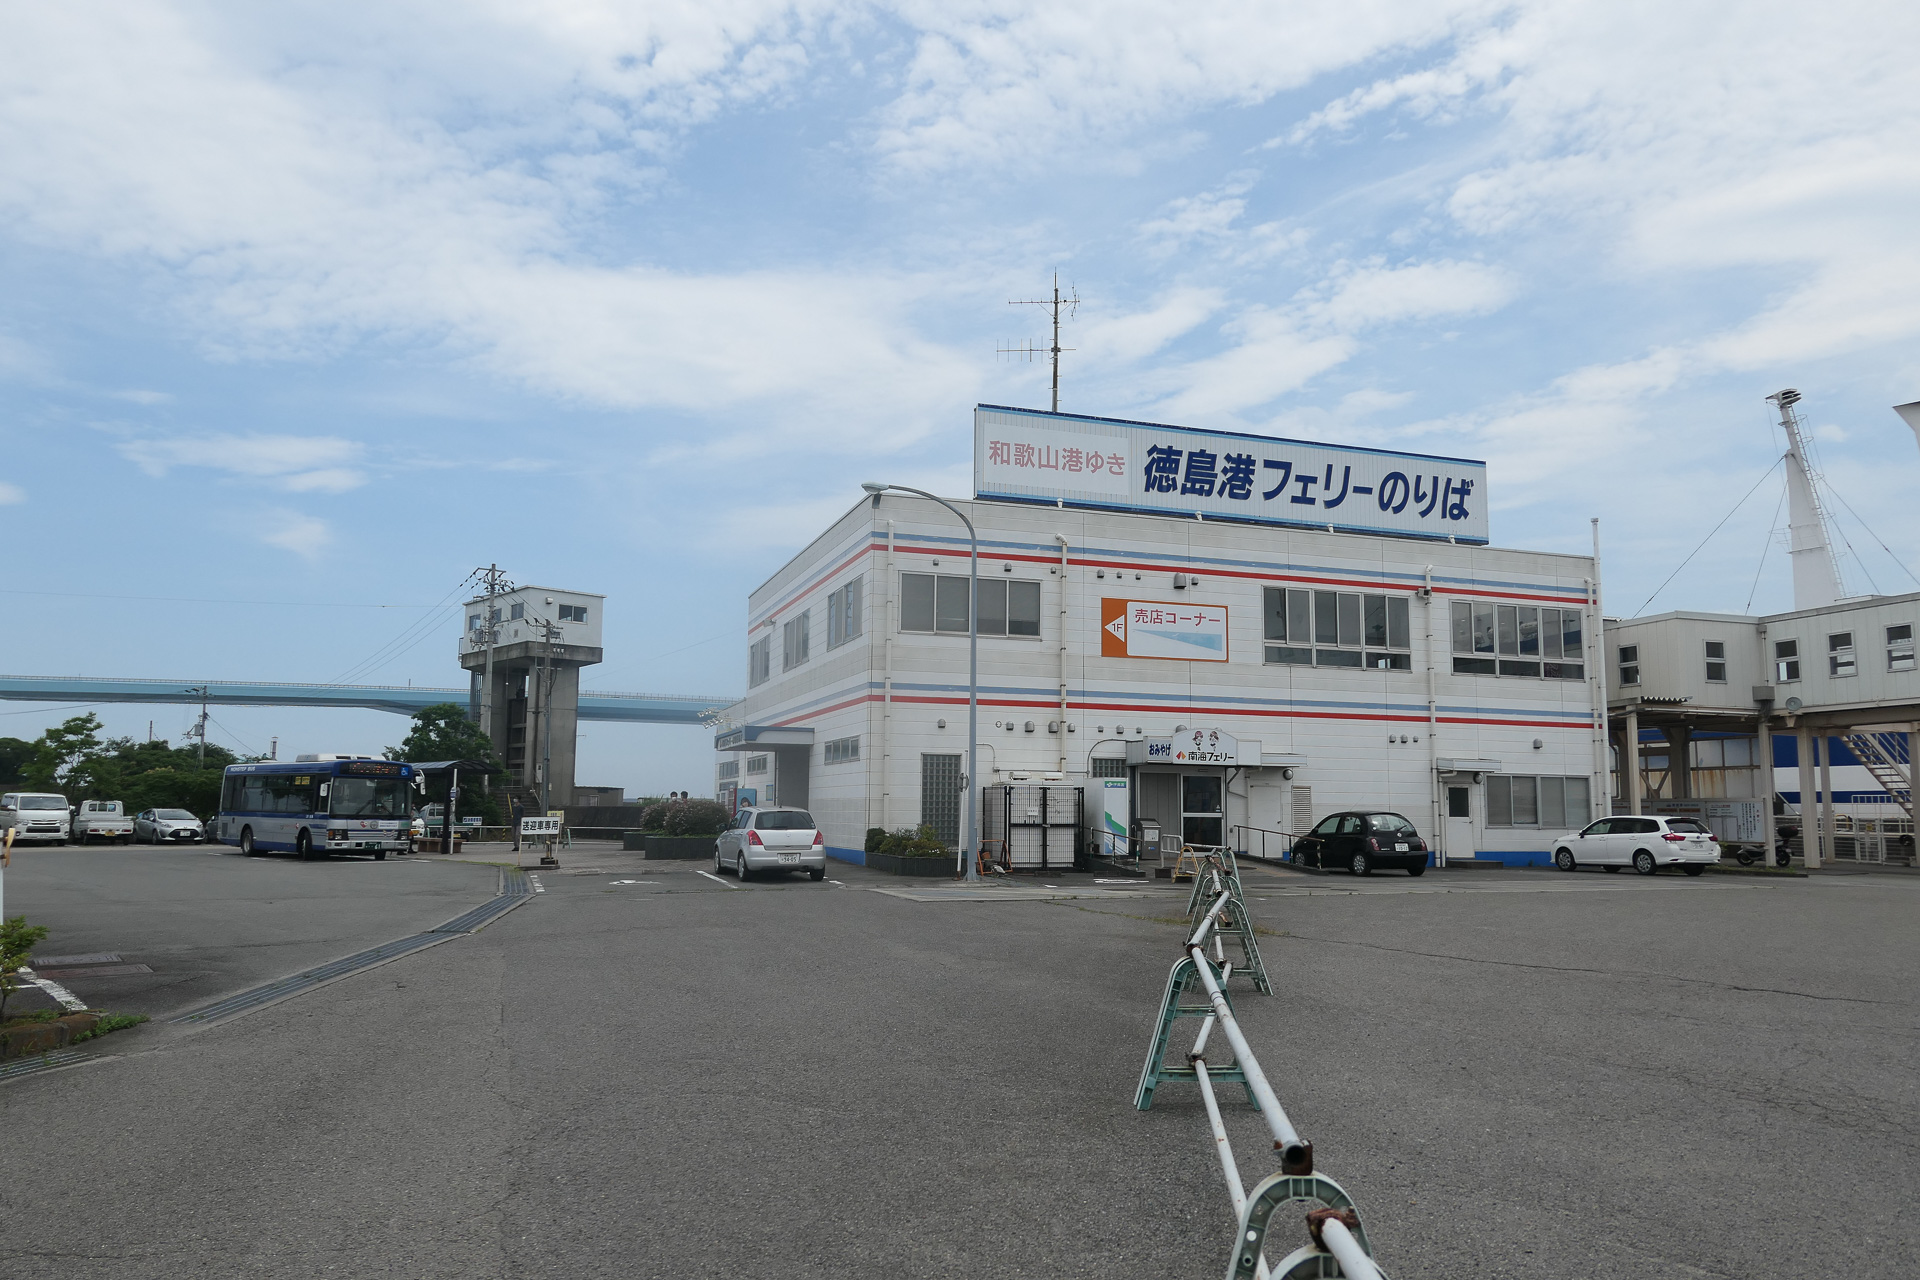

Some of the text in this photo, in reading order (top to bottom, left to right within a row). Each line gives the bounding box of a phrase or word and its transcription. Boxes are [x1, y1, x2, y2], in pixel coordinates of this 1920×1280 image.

[988, 440, 1126, 475] 和歌山港ゆき
[1143, 443, 1475, 521] 徳島港フェリーのりば
[1134, 608, 1221, 627] 売店コーナー
[1111, 623, 1124, 632] 1F
[1149, 743, 1172, 756] おみやげ
[1188, 751, 1234, 761] 南海フェリー
[522, 820, 559, 831] 送迎車専用
